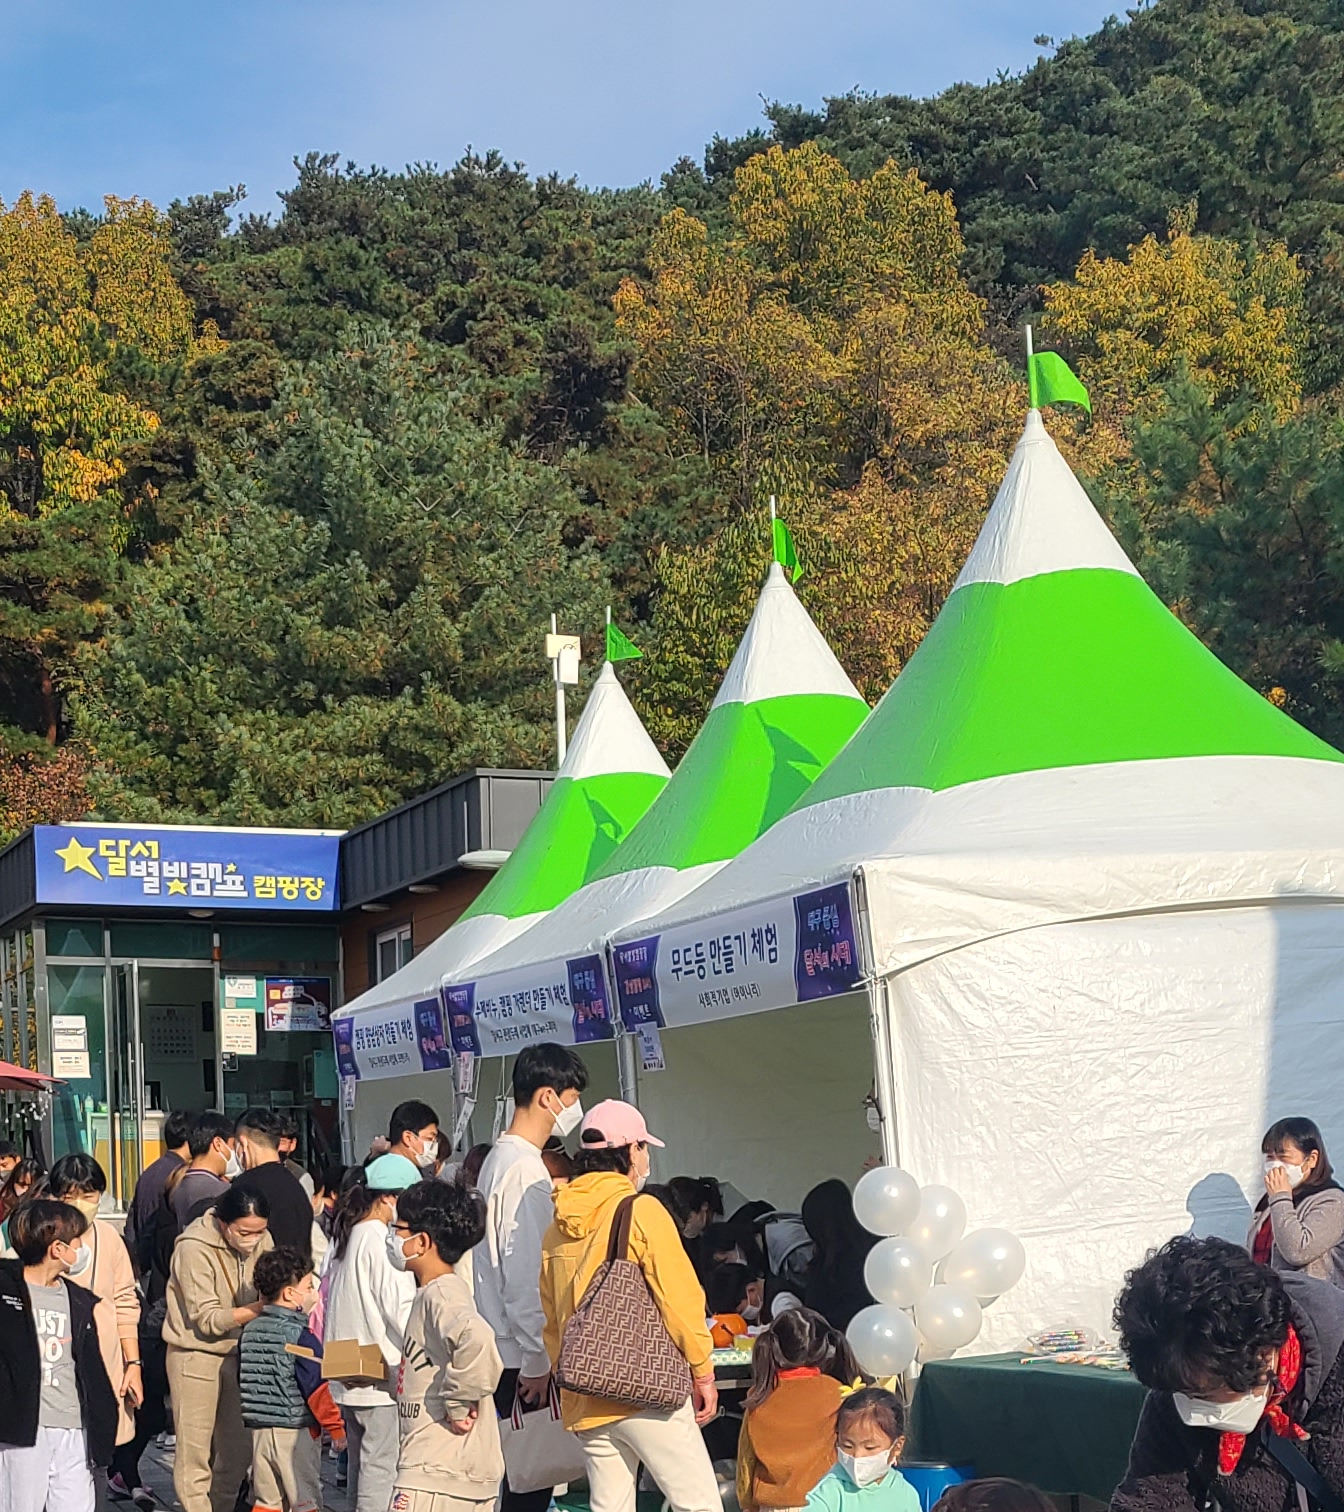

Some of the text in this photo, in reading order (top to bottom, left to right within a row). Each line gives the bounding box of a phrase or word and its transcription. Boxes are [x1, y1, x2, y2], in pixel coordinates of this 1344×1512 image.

[253, 875, 327, 901] 캠핑장
[670, 940, 707, 983] 무드등
[708, 930, 748, 976] 만들기
[751, 922, 778, 964] 체험
[532, 987, 555, 1011] 만들기
[552, 982, 570, 1006] 체험
[698, 987, 730, 1009] 사회적기업
[33, 1308, 68, 1338] UST
